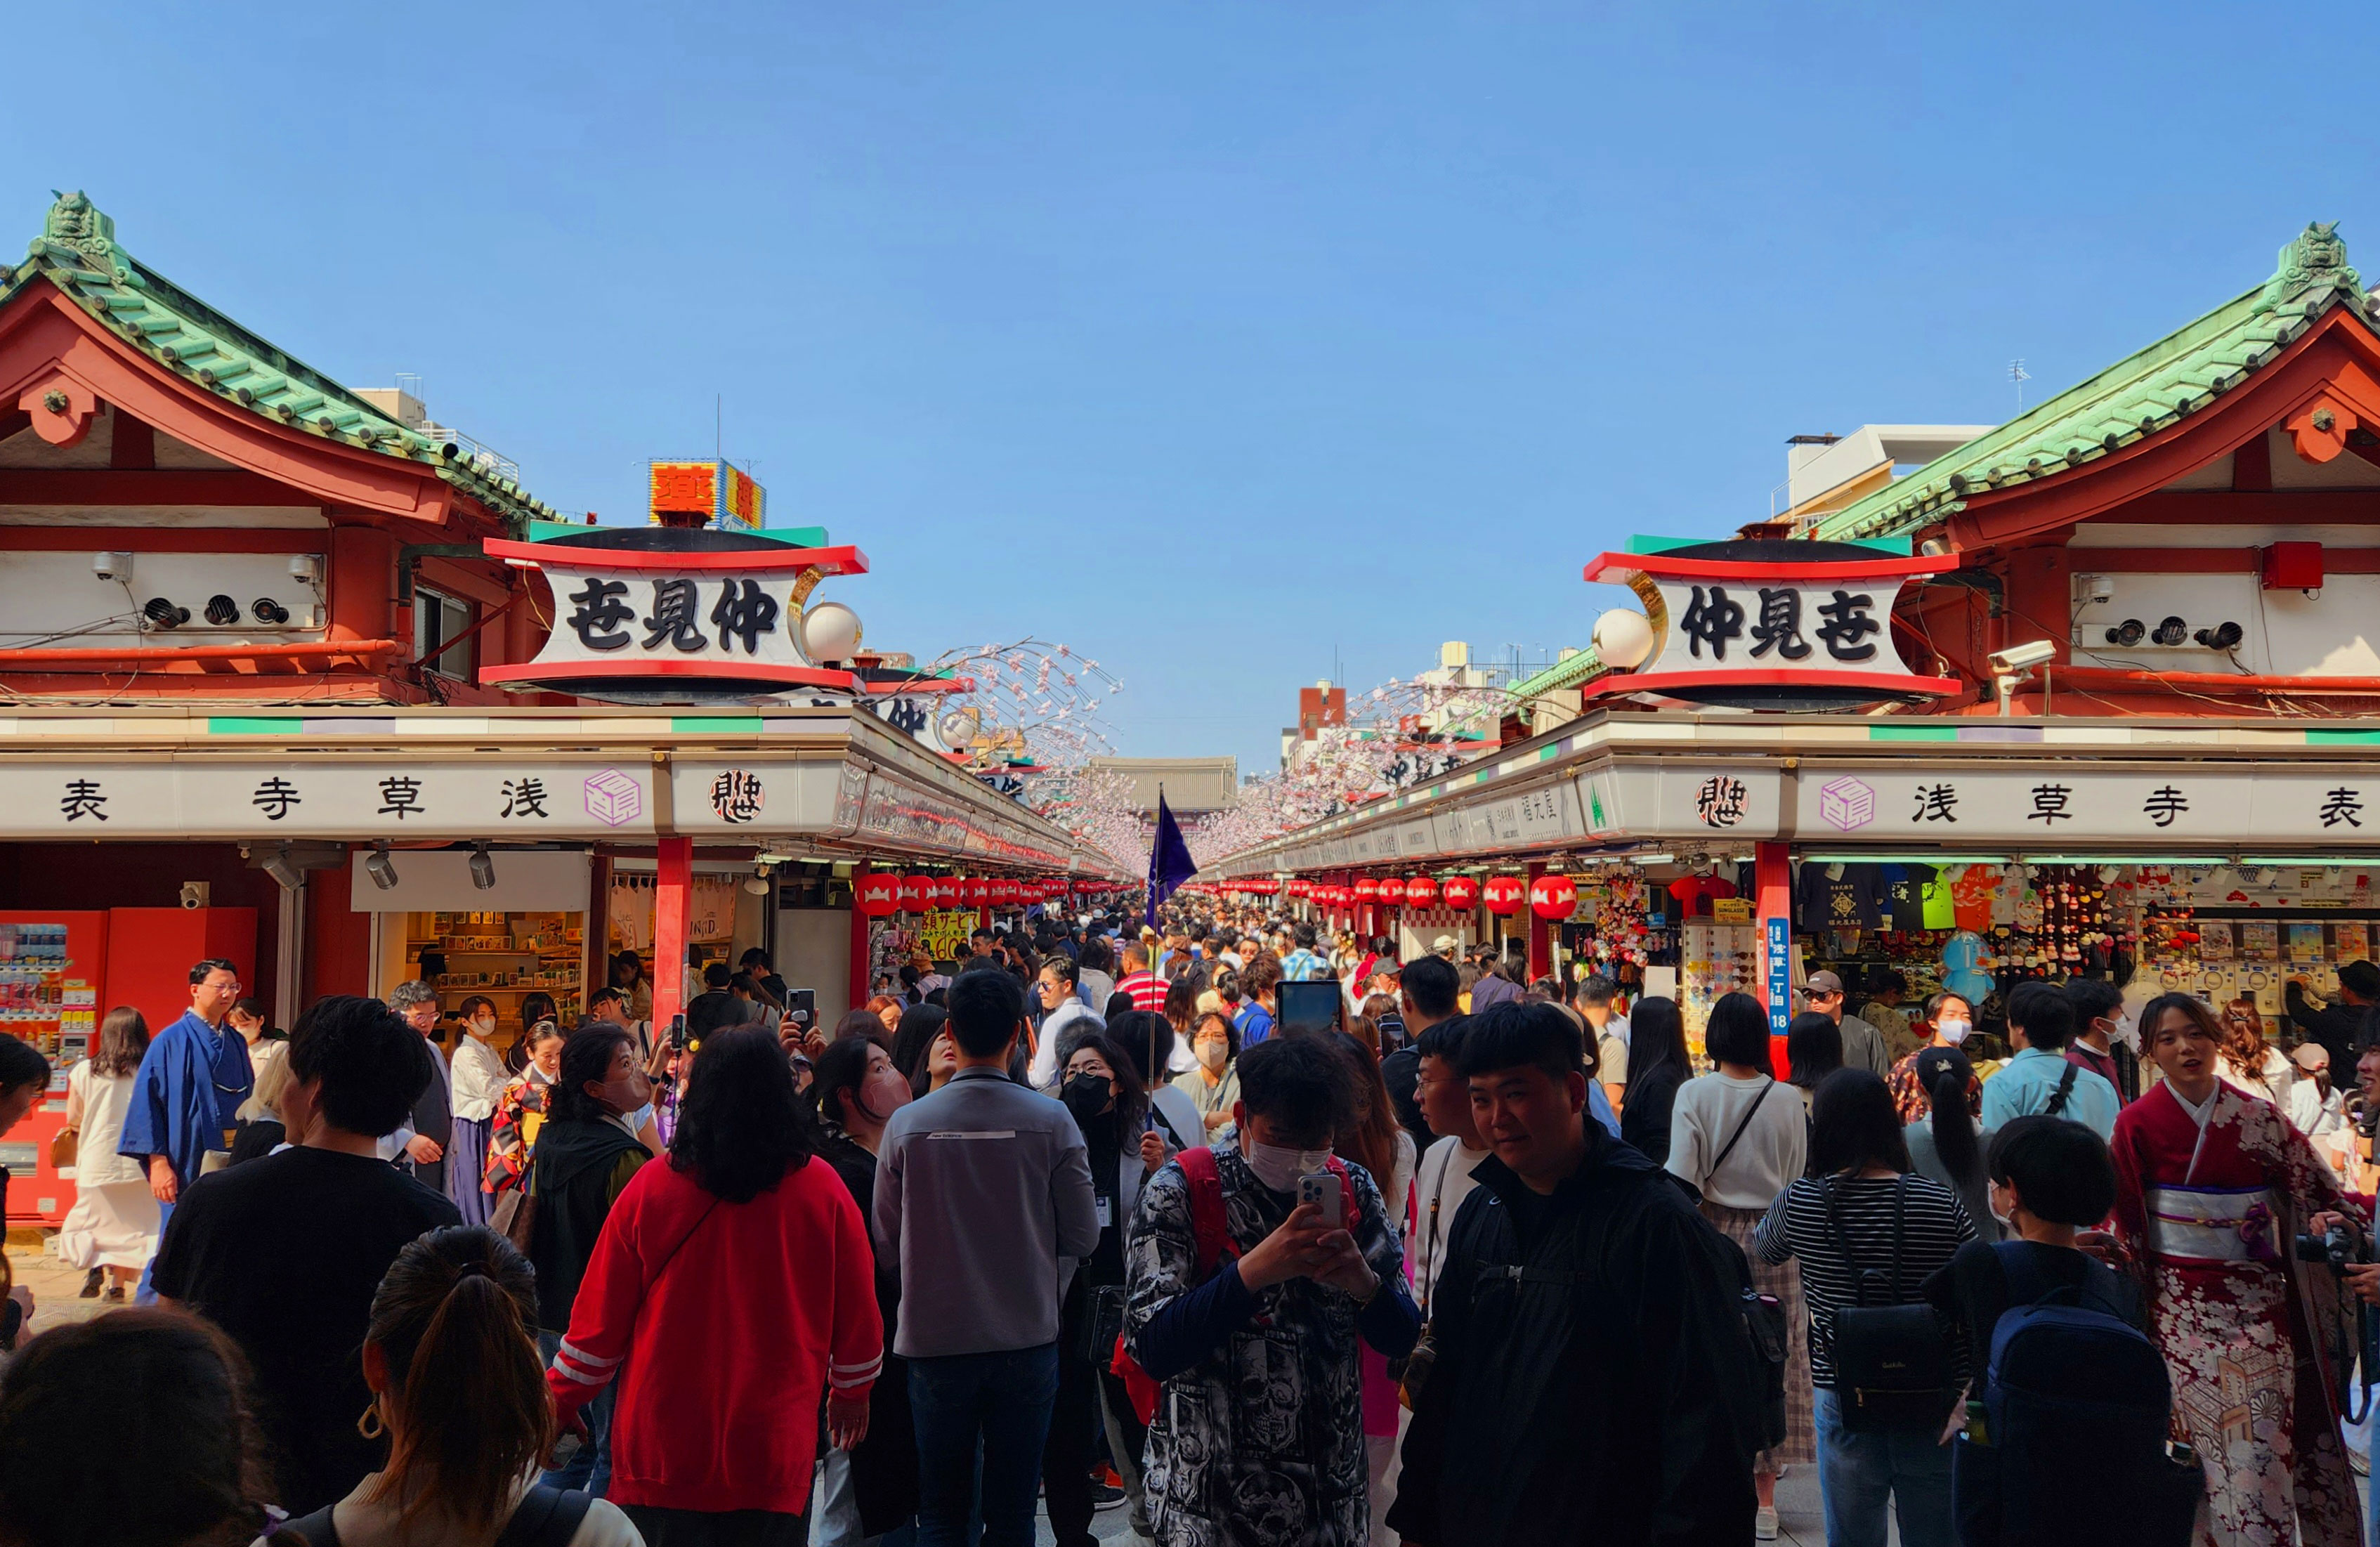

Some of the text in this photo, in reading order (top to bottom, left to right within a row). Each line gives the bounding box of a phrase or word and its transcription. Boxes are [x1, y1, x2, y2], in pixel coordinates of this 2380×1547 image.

[1681, 585, 1881, 660] 仲見世
[1922, 882, 1944, 892] APAN
[1772, 1014, 1787, 1028] 18
